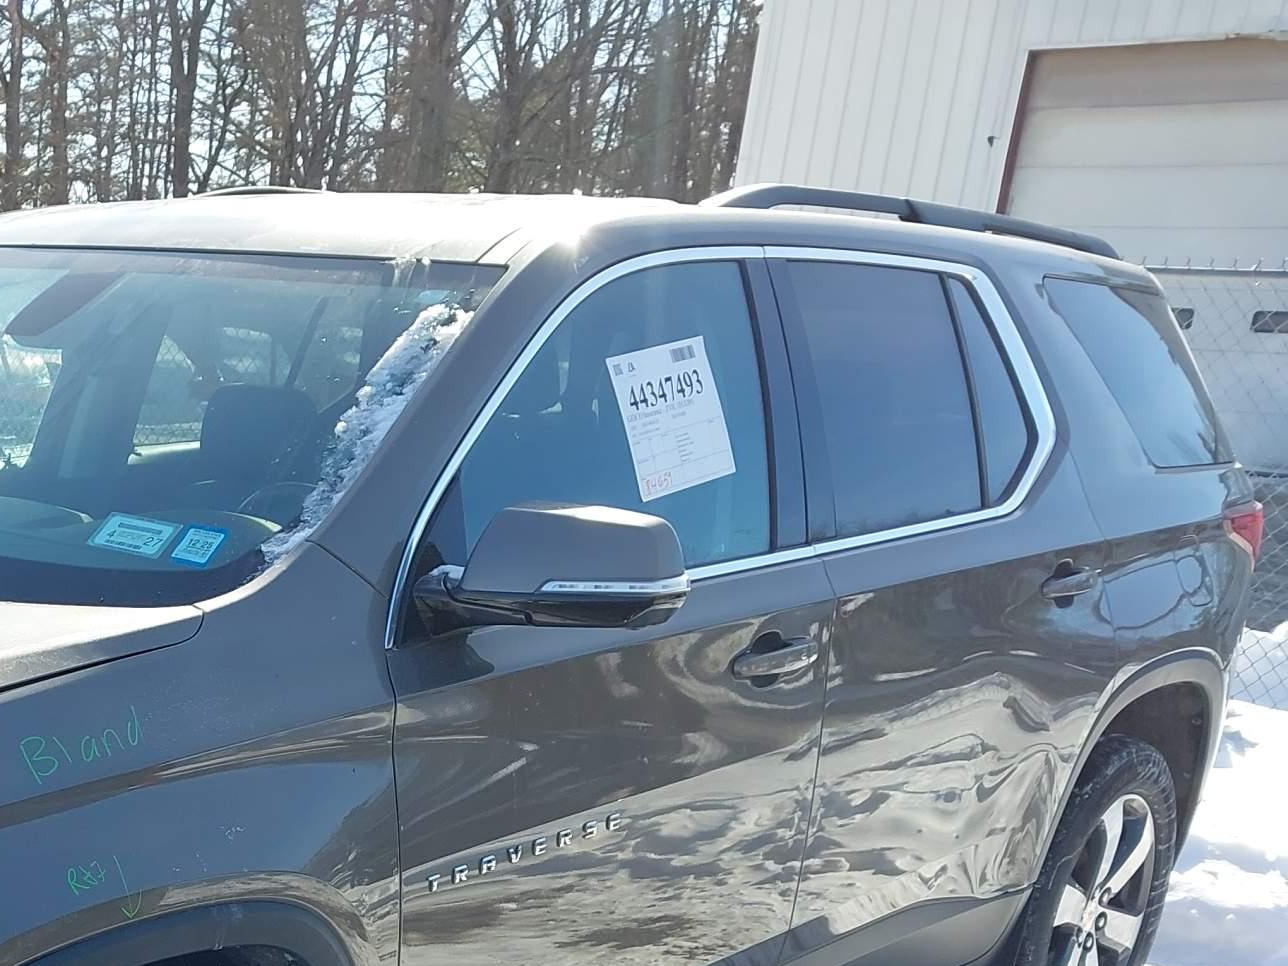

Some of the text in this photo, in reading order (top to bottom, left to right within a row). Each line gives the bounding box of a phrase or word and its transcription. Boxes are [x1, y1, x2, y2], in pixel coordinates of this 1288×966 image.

[629, 369, 704, 411] 44347493
[107, 530, 117, 539] 4
[143, 537, 163, 548] 27
[427, 813, 623, 892] TRAVERSE
